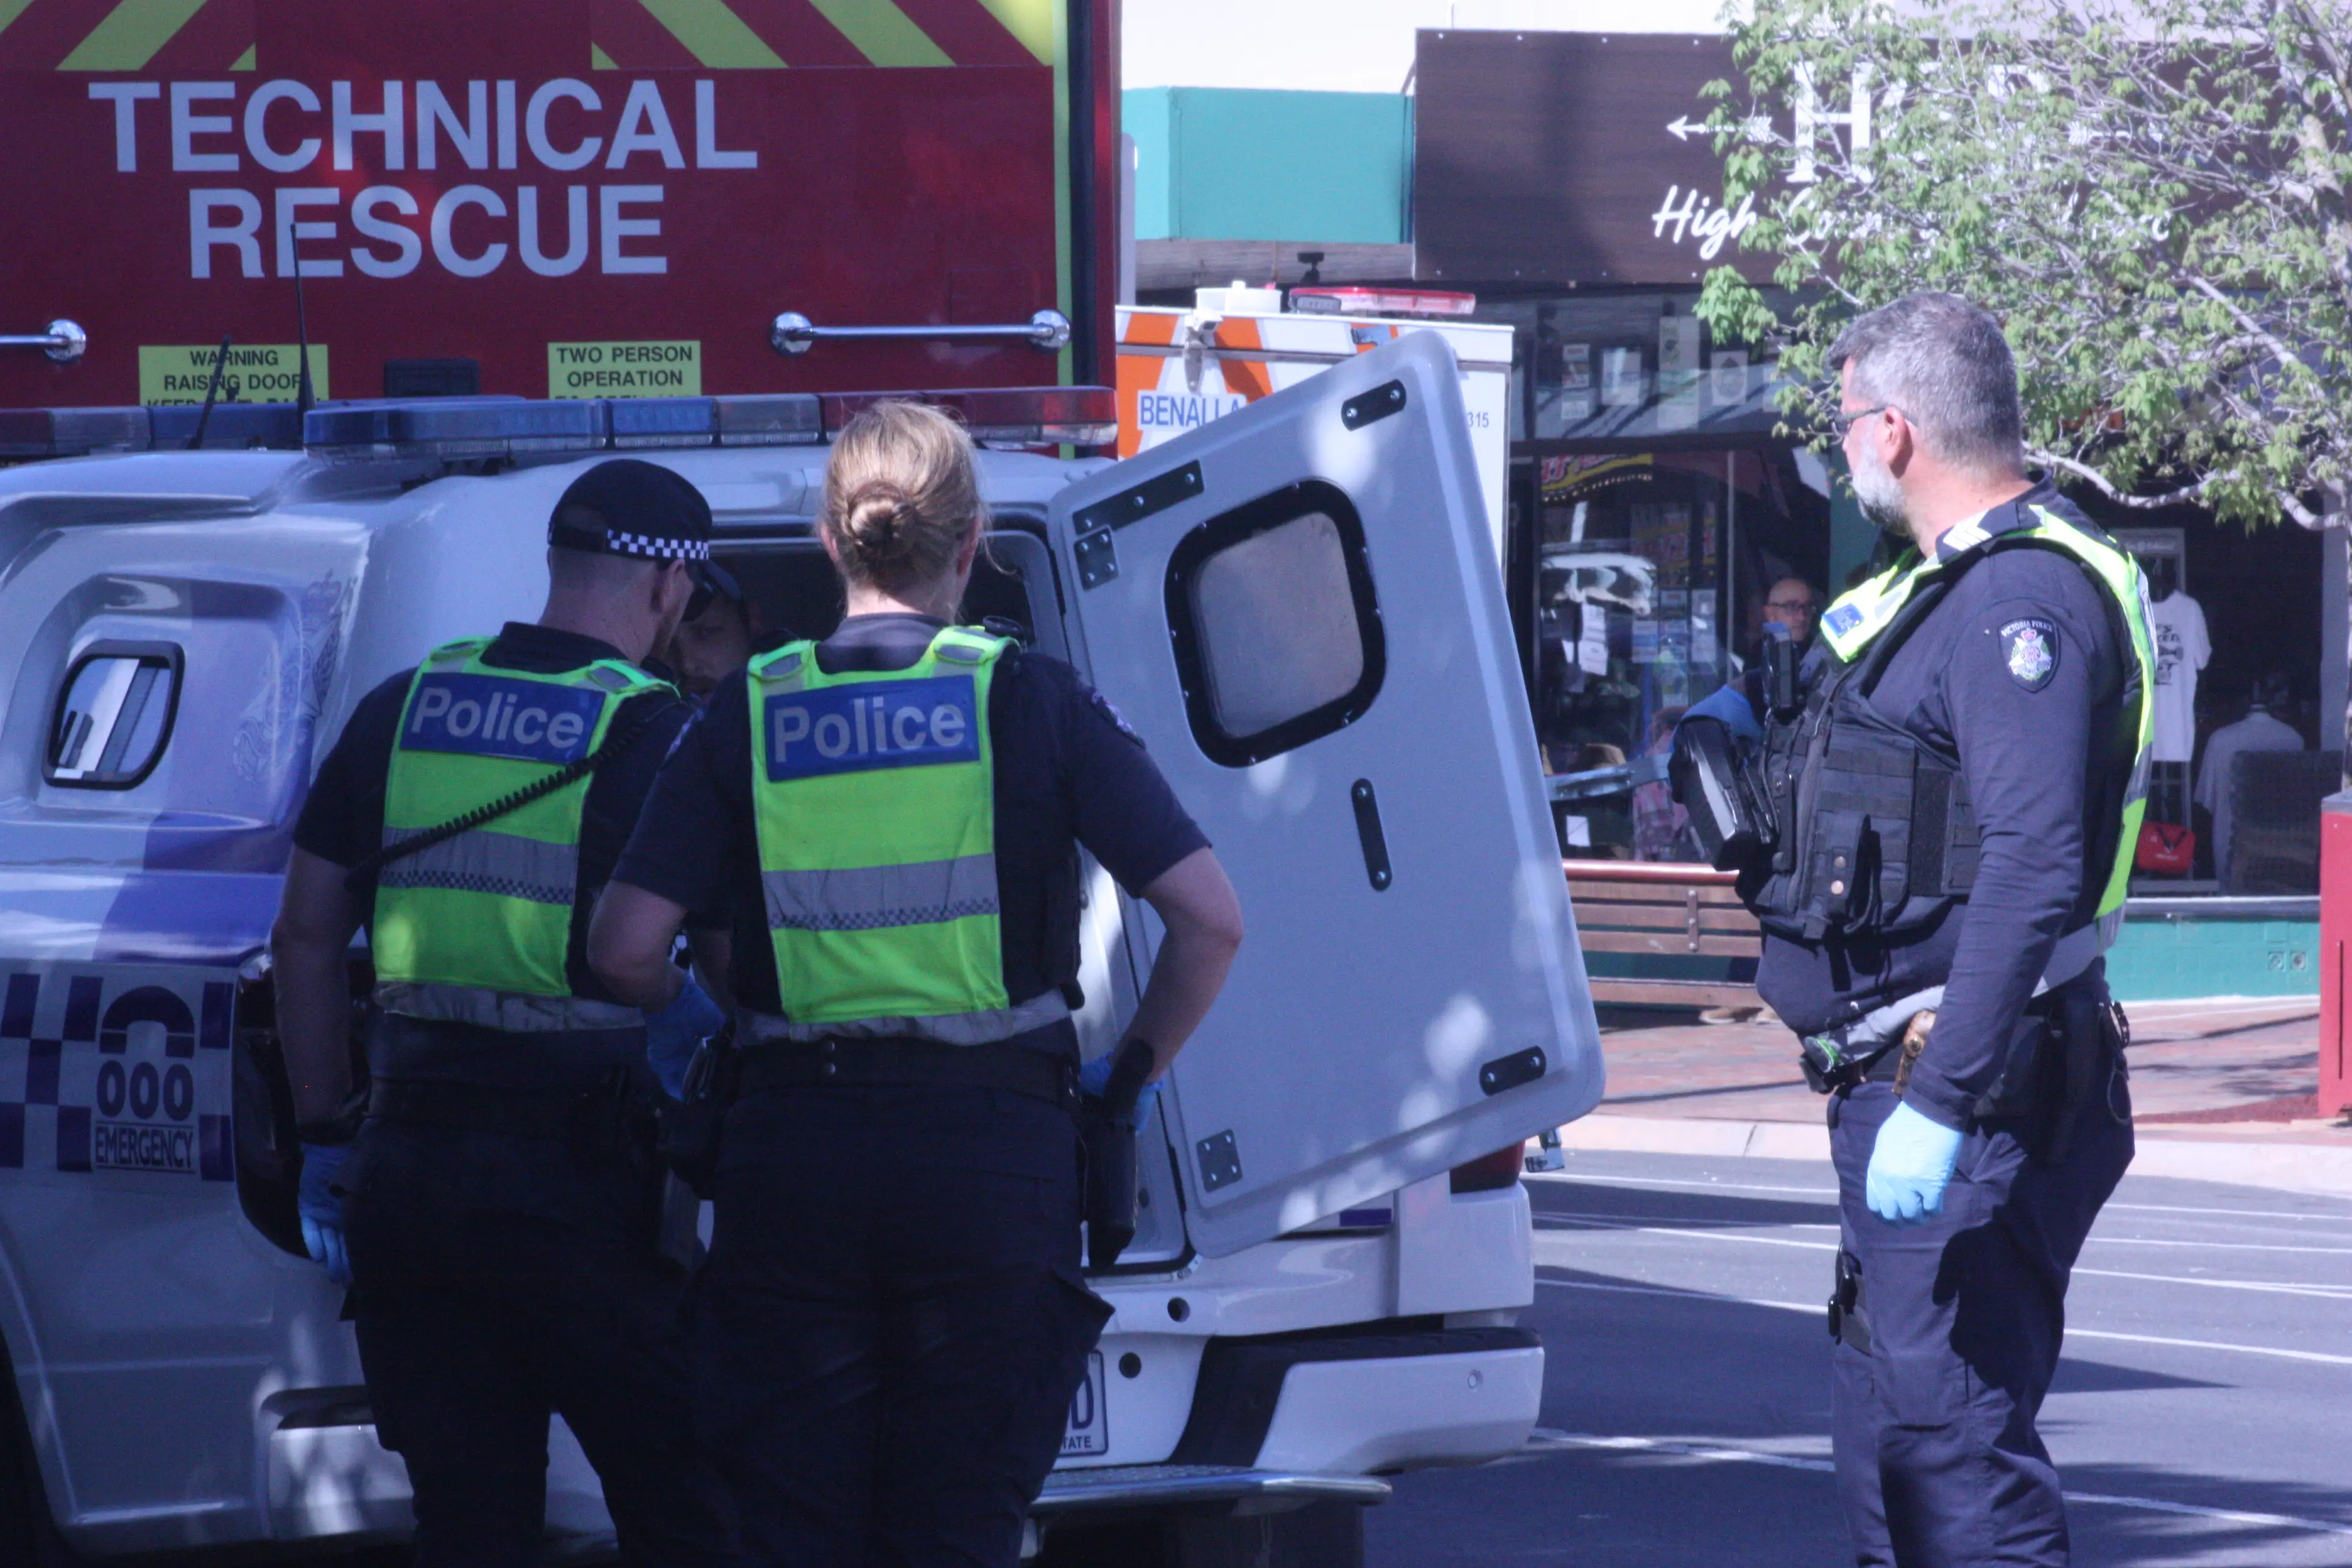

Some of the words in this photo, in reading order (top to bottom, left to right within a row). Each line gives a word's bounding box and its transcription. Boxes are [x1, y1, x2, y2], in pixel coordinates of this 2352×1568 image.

[88, 78, 758, 173] TECHNICAL
[189, 184, 668, 279] RESCUE
[1652, 185, 1757, 260] High
[190, 350, 278, 366] WARNING
[557, 347, 603, 363] TWO
[612, 345, 692, 363] PERSON
[567, 370, 683, 387] OPERATION
[2000, 620, 2031, 636] VICTORIA
[411, 687, 584, 748] Police
[774, 697, 967, 763] Police
[97, 1059, 194, 1121] 000
[95, 1126, 193, 1169] EMERGENCY
